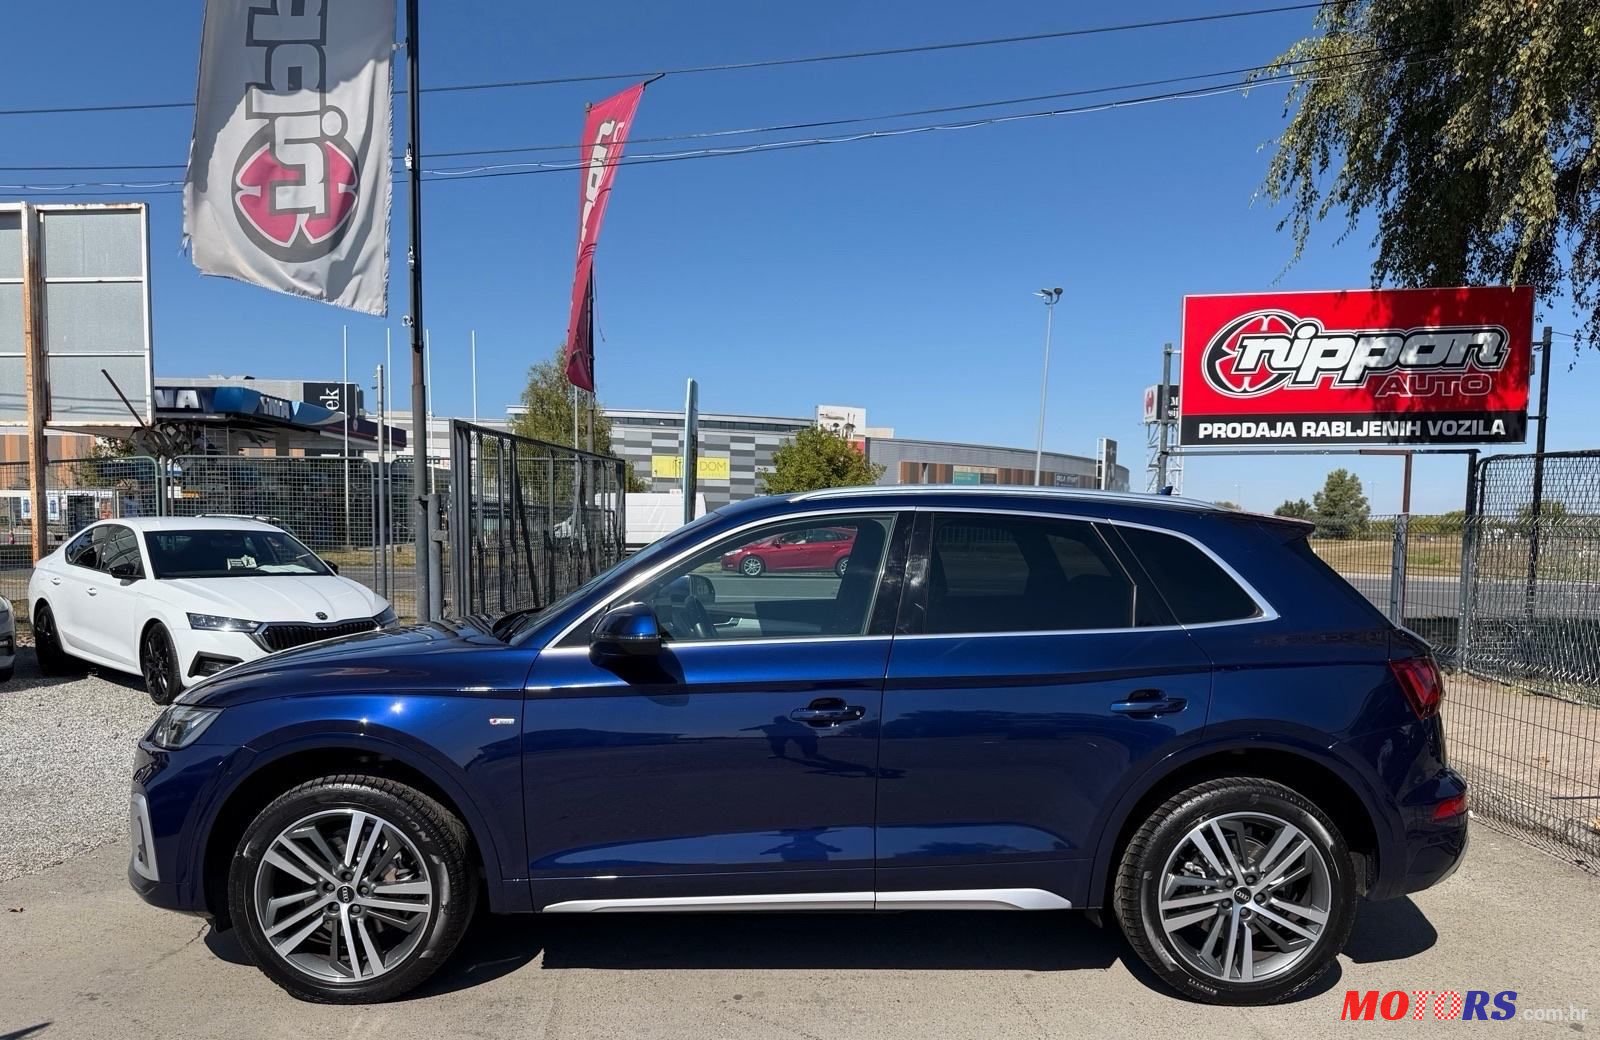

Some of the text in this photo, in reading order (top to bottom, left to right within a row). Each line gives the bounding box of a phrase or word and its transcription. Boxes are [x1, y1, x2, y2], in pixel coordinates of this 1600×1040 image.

[1235, 322, 1502, 383] nippon
[1375, 374, 1492, 398] AUTO
[1199, 419, 1506, 439] PRODAJA RABLJENIH VOZILA
